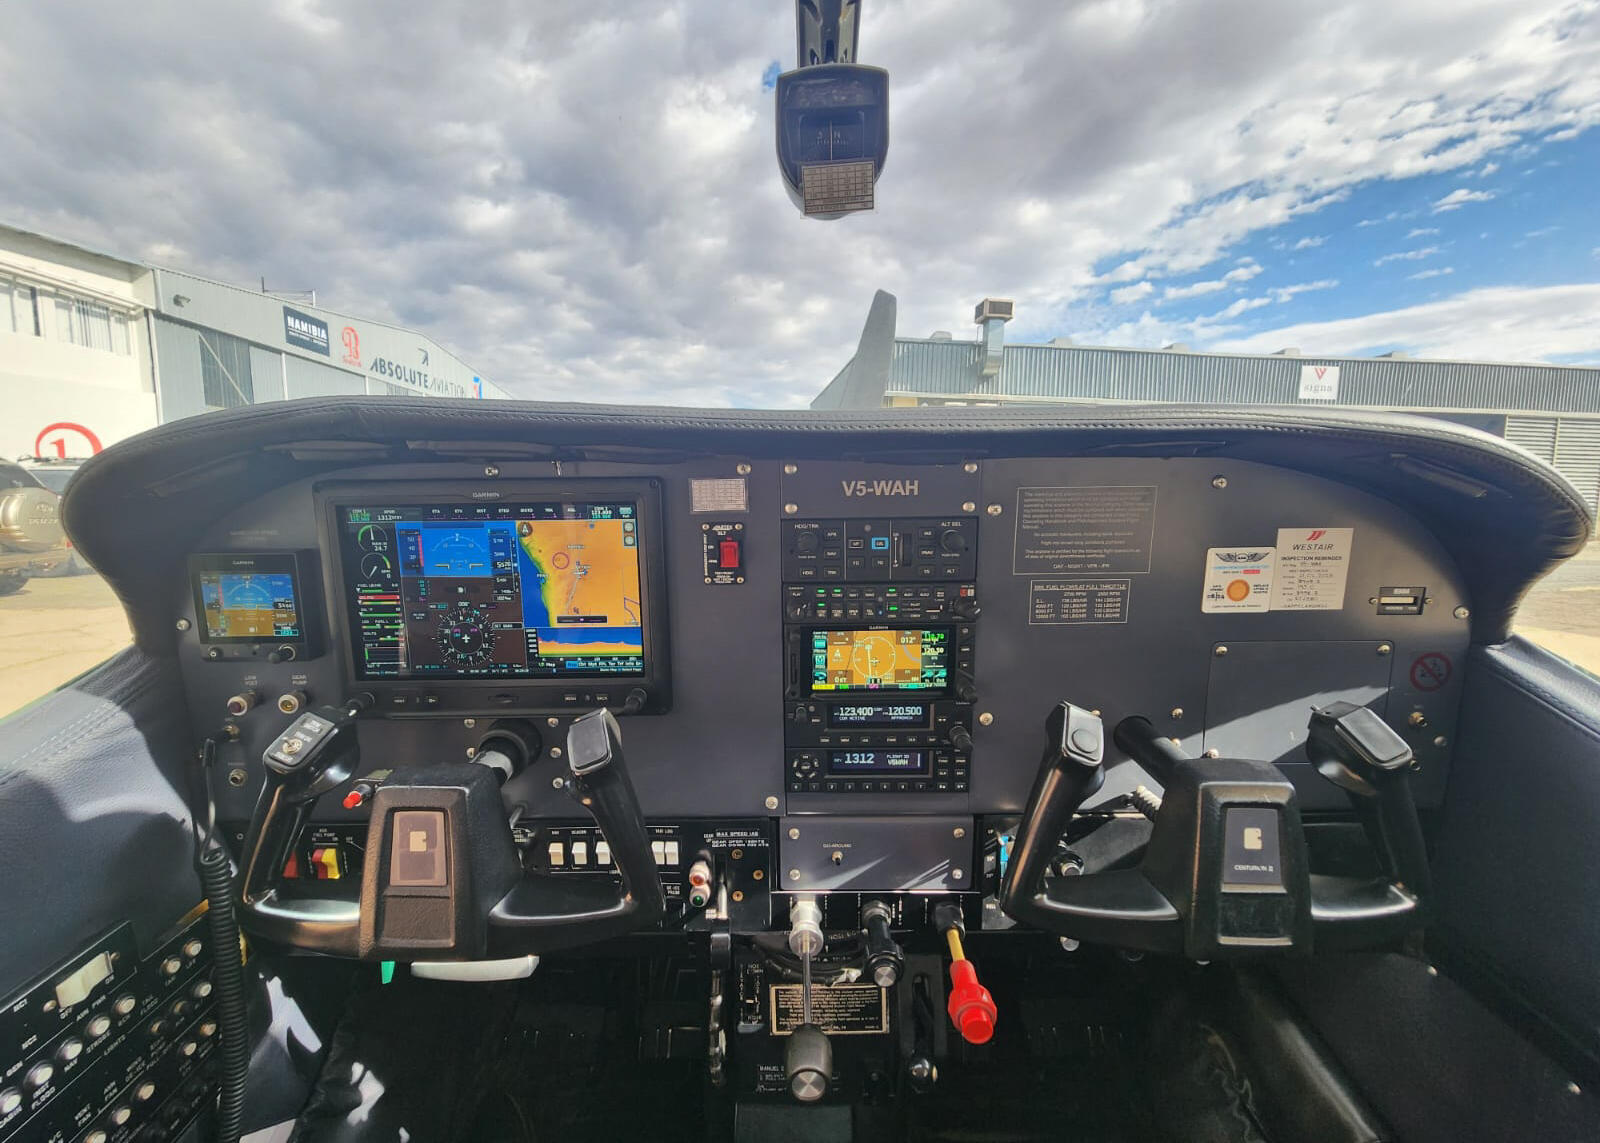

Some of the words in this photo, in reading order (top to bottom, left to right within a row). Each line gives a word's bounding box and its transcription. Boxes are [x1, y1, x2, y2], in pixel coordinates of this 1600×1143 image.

[287, 315, 327, 340] NAMIBIA
[370, 357, 429, 388] ABSOLUTE
[841, 480, 920, 496] V5-WAH
[839, 706, 874, 716] 123.400
[888, 706, 922, 716] 120.500
[844, 753, 874, 764] 1312
[104, 974, 114, 984] ON
[104, 1034, 126, 1056] LIGHTS
[31, 1086, 56, 1110] FLOOD
